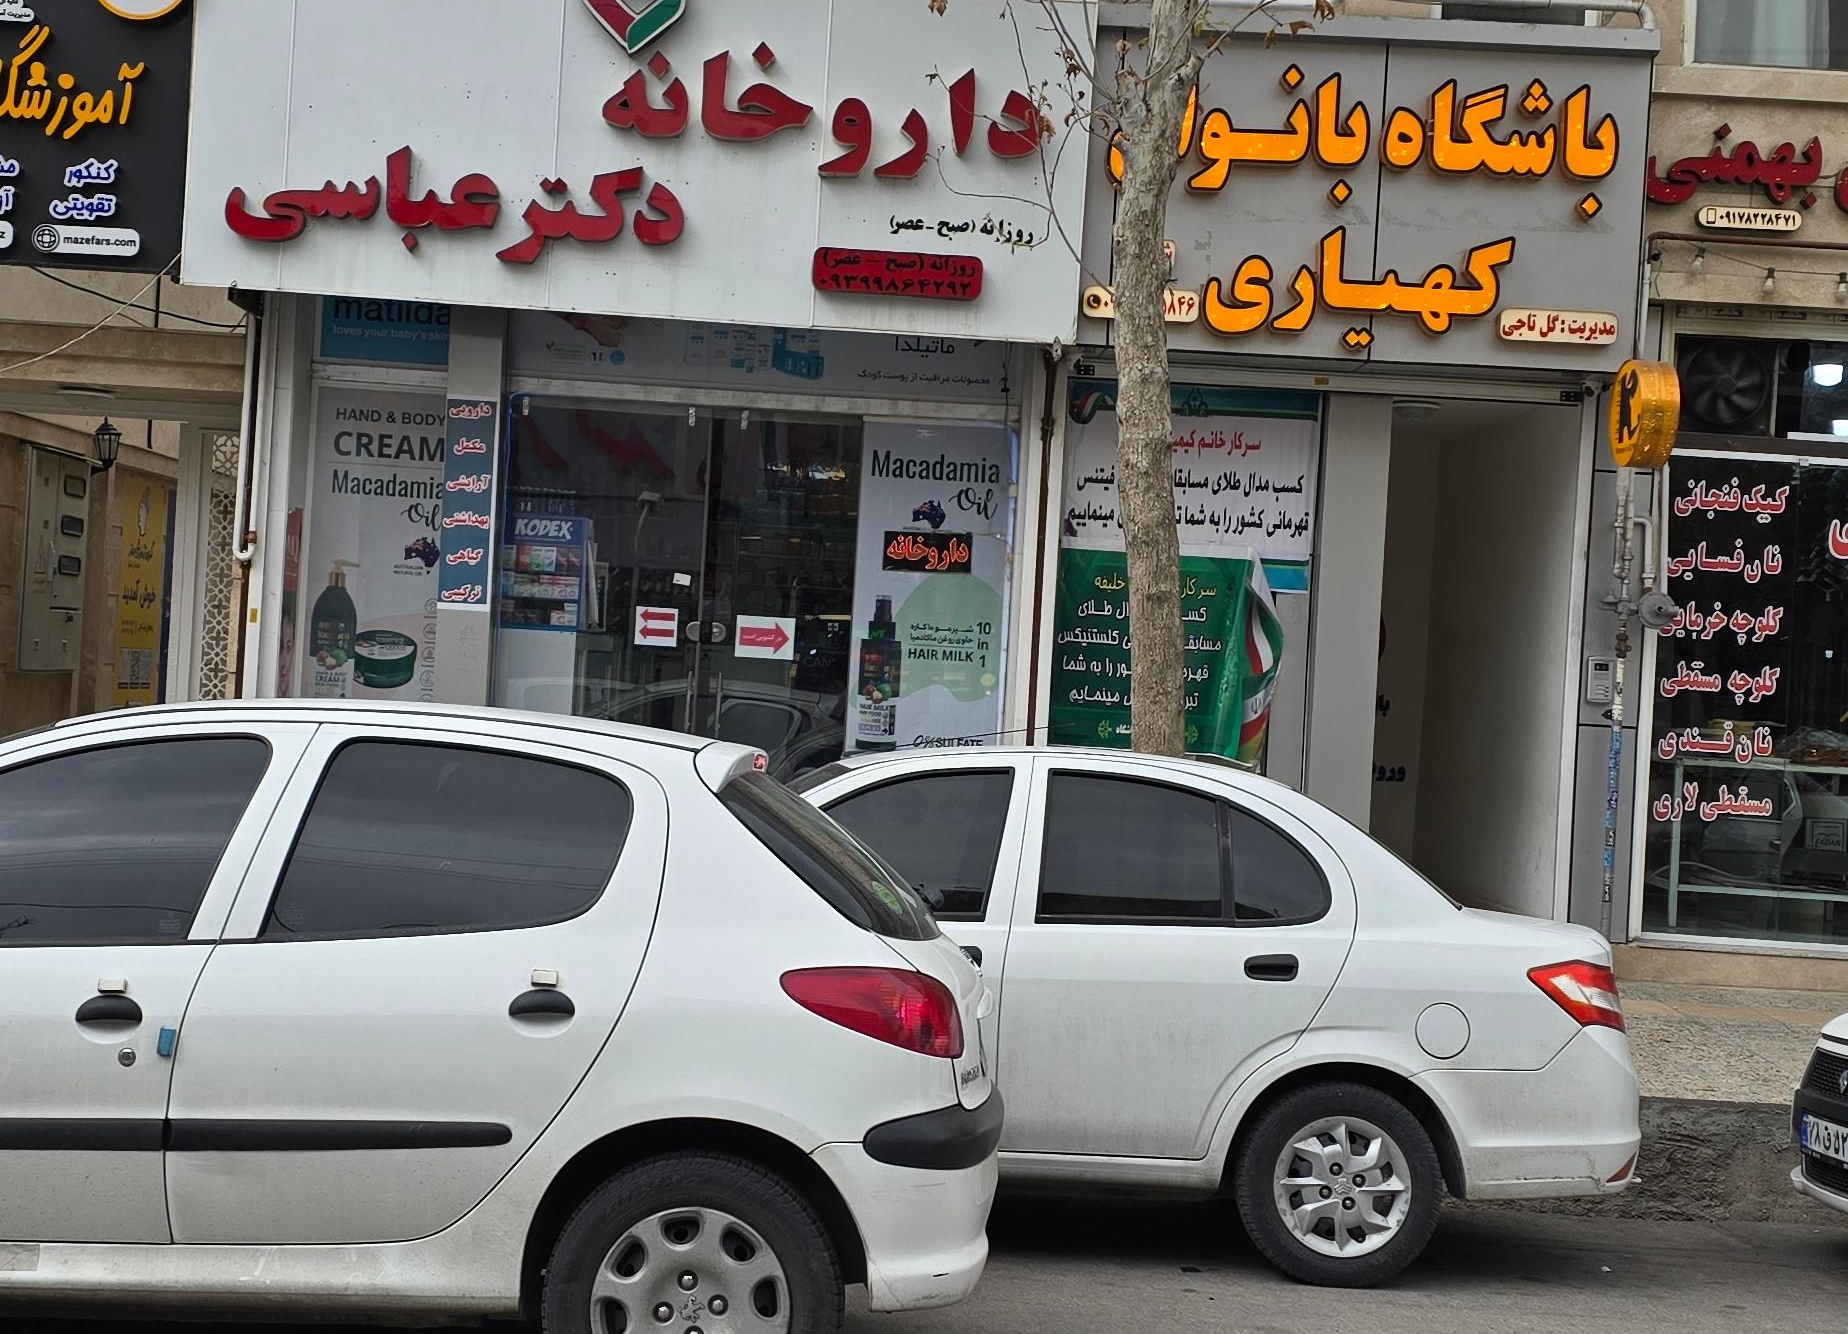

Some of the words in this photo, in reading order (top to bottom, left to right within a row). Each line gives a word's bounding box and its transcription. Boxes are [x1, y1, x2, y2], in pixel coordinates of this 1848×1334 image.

[0, 24, 145, 140] آموزشگ
[602, 42, 1043, 178] داروخانه
[1106, 63, 1372, 207] بانوا
[1380, 76, 1621, 220] باشگاه
[65, 157, 118, 186] کنکور
[51, 195, 116, 219] تقویتی
[225, 145, 500, 254] عباسی
[495, 165, 685, 264] دکتر
[63, 235, 137, 247] mazefars.com
[979, 218, 1034, 245] روزانه
[930, 257, 976, 277] روزانه
[1201, 224, 1517, 351] کهیاری
[333, 325, 362, 335] loves
[364, 328, 388, 338] your
[391, 329, 426, 341] baby's
[1502, 313, 1537, 336] تاجی
[1540, 313, 1559, 337] گل
[1568, 321, 1616, 340] مدیریت
[895, 336, 956, 358] ماتیلدا
[857, 369, 883, 381] کودک
[882, 370, 909, 383] پوست
[952, 373, 990, 385] محصولات
[336, 407, 382, 423] HAND
[386, 411, 397, 424] &
[401, 412, 446, 427] BODY
[450, 403, 492, 418] دارویی
[333, 430, 444, 462] CREAM
[453, 438, 487, 455] مکمل
[1197, 430, 1226, 459] خانم
[871, 449, 1000, 484] Macadamia
[331, 469, 444, 500] Macadamia
[446, 475, 492, 493] آرایشی
[1173, 468, 1209, 496] مسابقا
[1211, 471, 1242, 496] طلای
[1243, 472, 1270, 498] مدال
[1271, 473, 1305, 503] کسب
[948, 487, 998, 520] Oil
[1674, 476, 1742, 519] فنجانی
[1742, 484, 1790, 523] کیک
[400, 502, 441, 532] Oil
[443, 510, 490, 529] بهداشتی
[1184, 502, 1207, 527] شما
[1208, 510, 1221, 533] به
[1223, 507, 1234, 534] را
[1234, 506, 1265, 536] کشور
[1265, 509, 1310, 538] قهرمانی
[514, 518, 573, 540] KODEX
[446, 547, 483, 564] گیاهی
[887, 534, 969, 571] داروخانه
[441, 584, 482, 602] ترکیبی
[1094, 572, 1126, 593] خلیفه
[1077, 599, 1113, 617] طلای
[1181, 607, 1207, 622] کس
[976, 622, 992, 635] 10
[1728, 605, 1783, 645] کلوچه
[908, 648, 938, 661] HAIR
[942, 649, 974, 663] MILK
[977, 639, 989, 650] in
[1184, 635, 1222, 653] مسابق
[979, 655, 986, 668] 1
[1062, 653, 1087, 671] شما
[1090, 659, 1102, 677] به
[1104, 657, 1114, 676] را
[1660, 660, 1722, 697] مسقطی
[1727, 666, 1781, 705] کلوچه
[1658, 721, 1734, 759] قندی
[1735, 726, 1773, 764] نان
[1653, 781, 1699, 821] لاری
[1700, 785, 1773, 822] مسقطی
